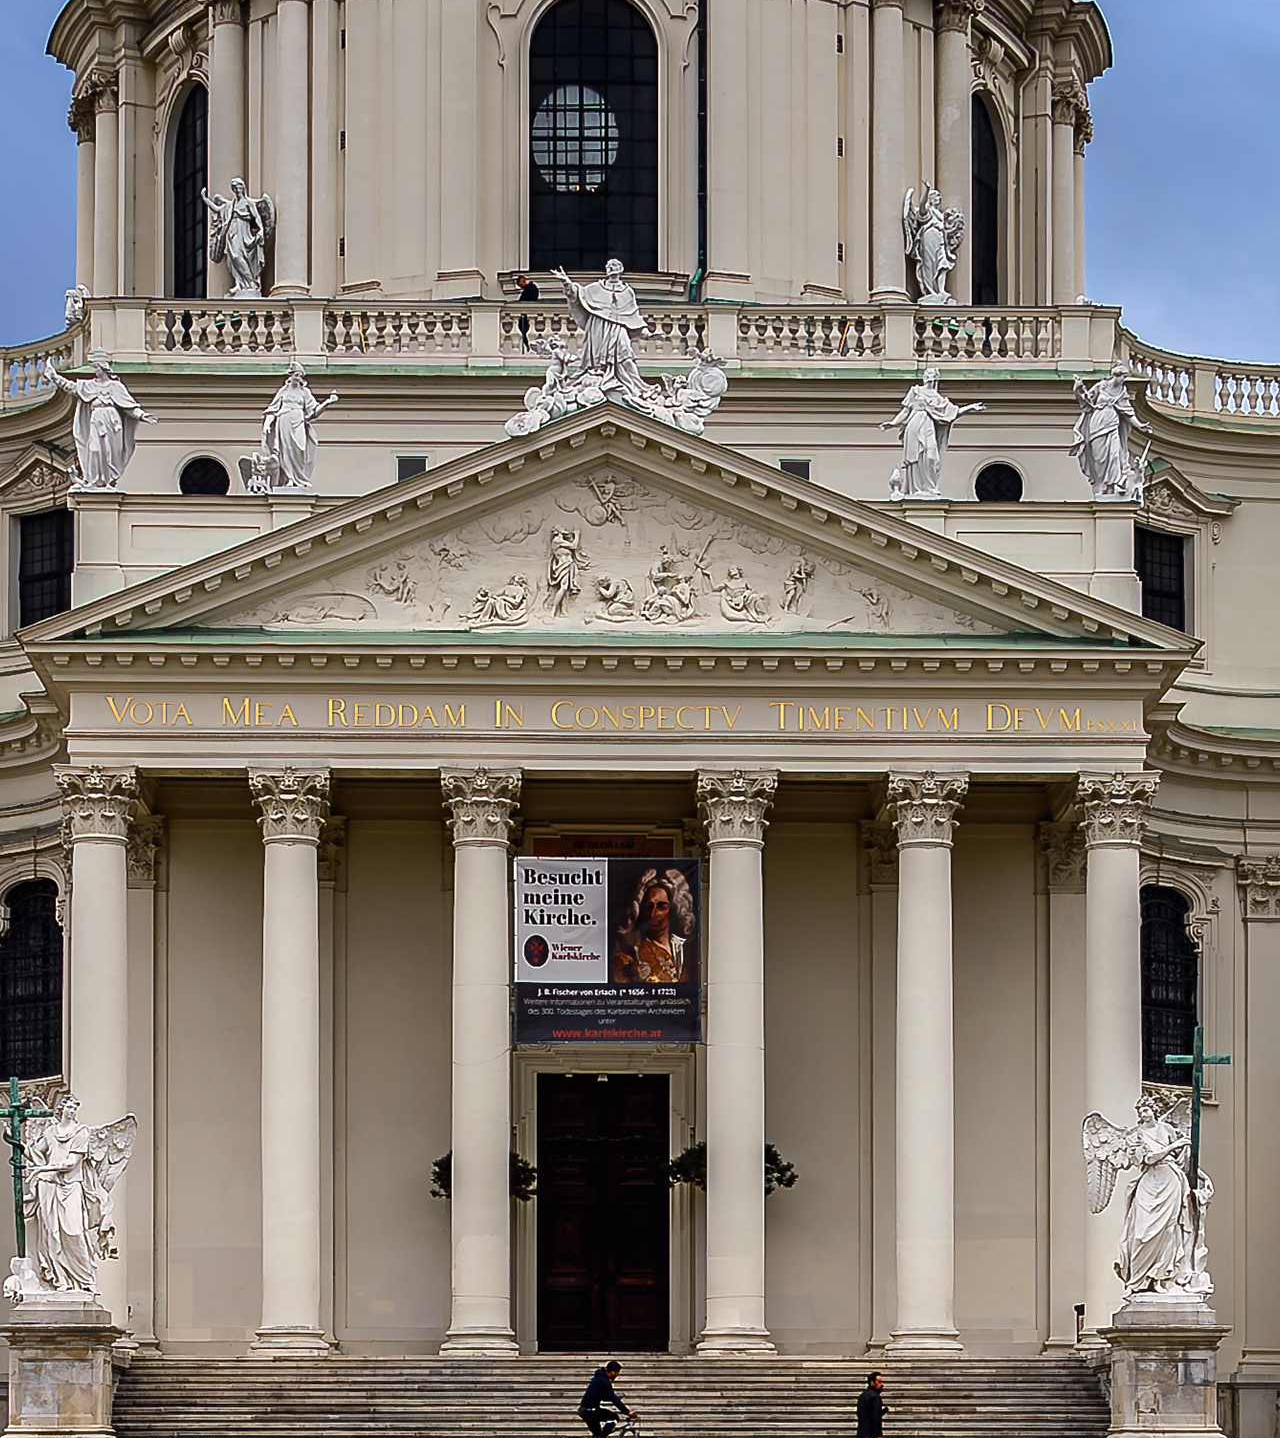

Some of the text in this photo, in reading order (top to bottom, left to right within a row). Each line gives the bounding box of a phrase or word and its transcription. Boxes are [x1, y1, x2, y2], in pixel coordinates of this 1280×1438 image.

[105, 696, 193, 727] VOTA
[222, 697, 299, 728] MEA
[326, 698, 466, 729] REDDAM
[493, 699, 525, 728] IN
[523, 868, 603, 885] Besucht
[523, 888, 585, 905] meine
[523, 908, 597, 925] Kirche.
[551, 943, 583, 952] Wiener
[551, 952, 601, 961] Karlskirche
[552, 988, 578, 996] Fischer
[594, 988, 617, 996] Erlach
[550, 998, 596, 1006] Informationen
[552, 1028, 662, 1038] www.karlskirche.at
